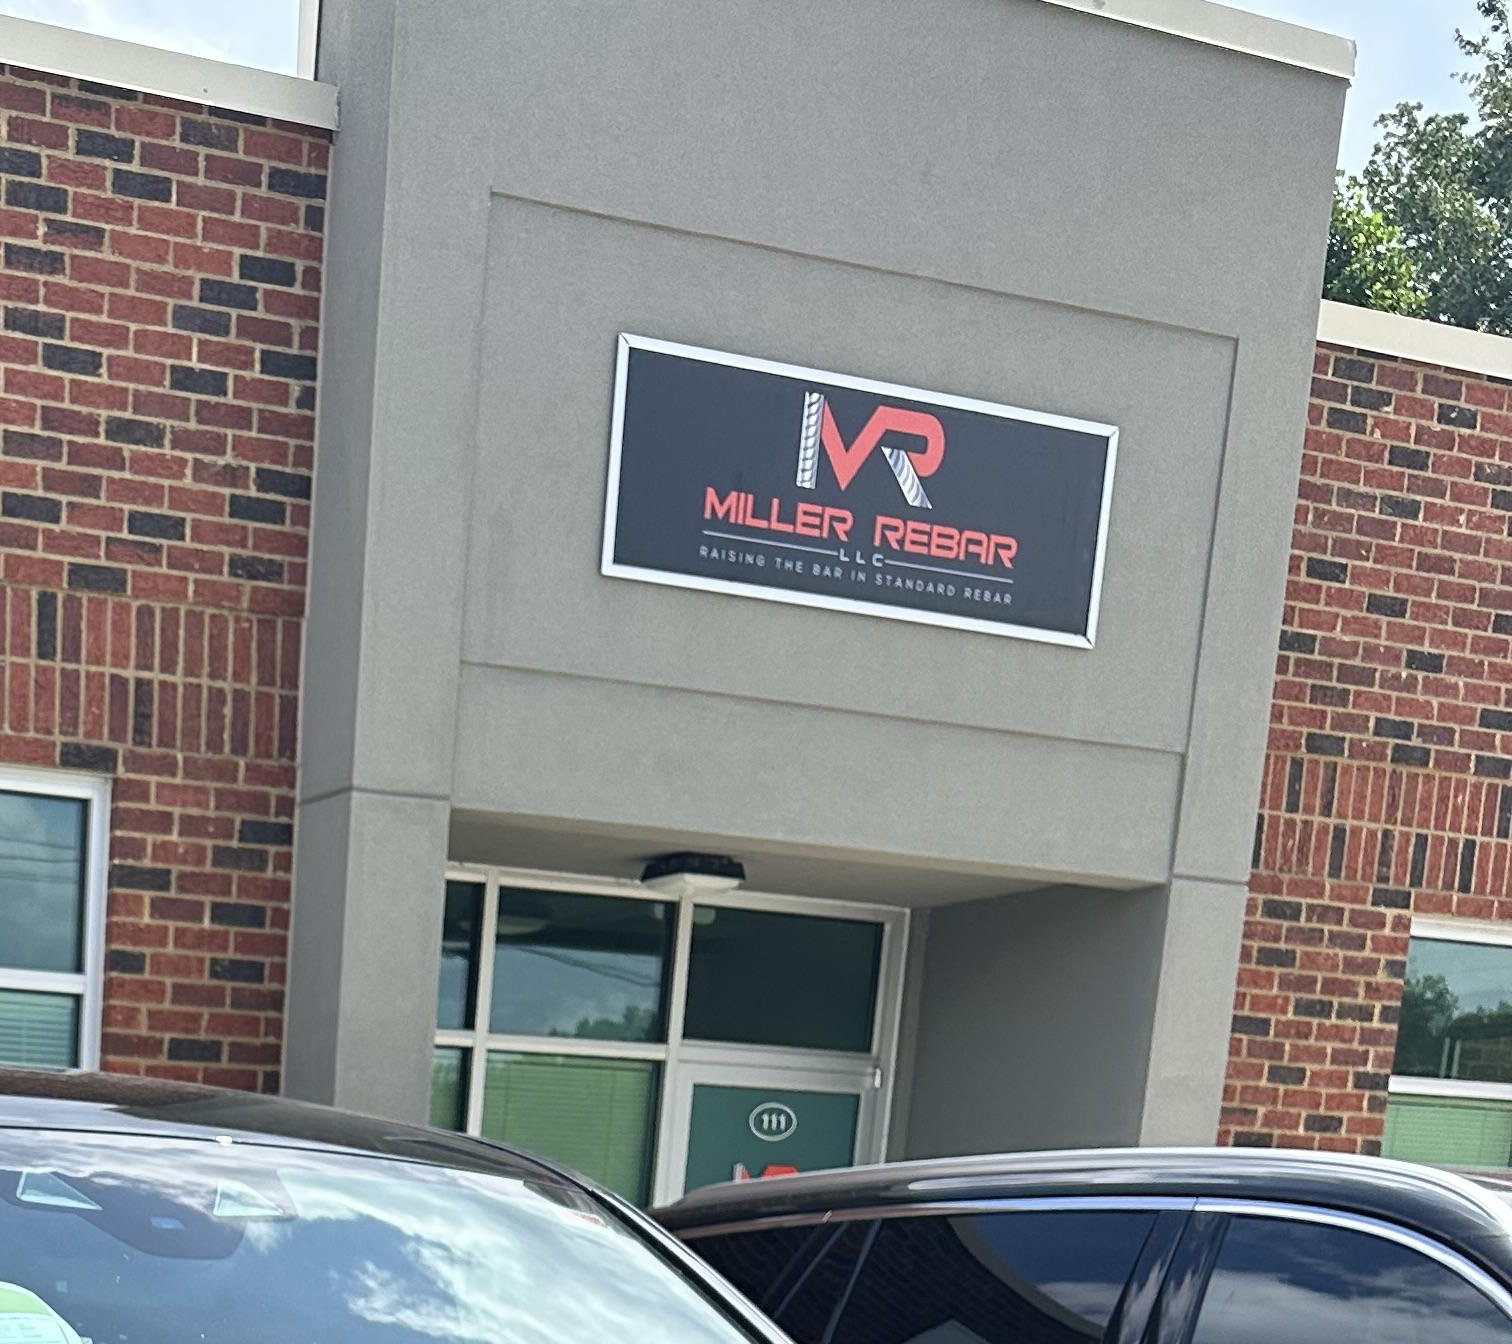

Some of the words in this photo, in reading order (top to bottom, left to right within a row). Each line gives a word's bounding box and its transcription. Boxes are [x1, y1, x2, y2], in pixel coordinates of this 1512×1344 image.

[703, 486, 854, 542] MILLER
[873, 515, 1019, 569] REBAR
[698, 545, 766, 568] RAISING
[774, 557, 804, 573] THE
[812, 563, 843, 579] BAR
[850, 571, 867, 583] IN
[875, 573, 956, 598] STANDARD
[964, 586, 1013, 605] REBAR
[839, 548, 885, 567] LLC
[761, 1112, 787, 1131] 111
